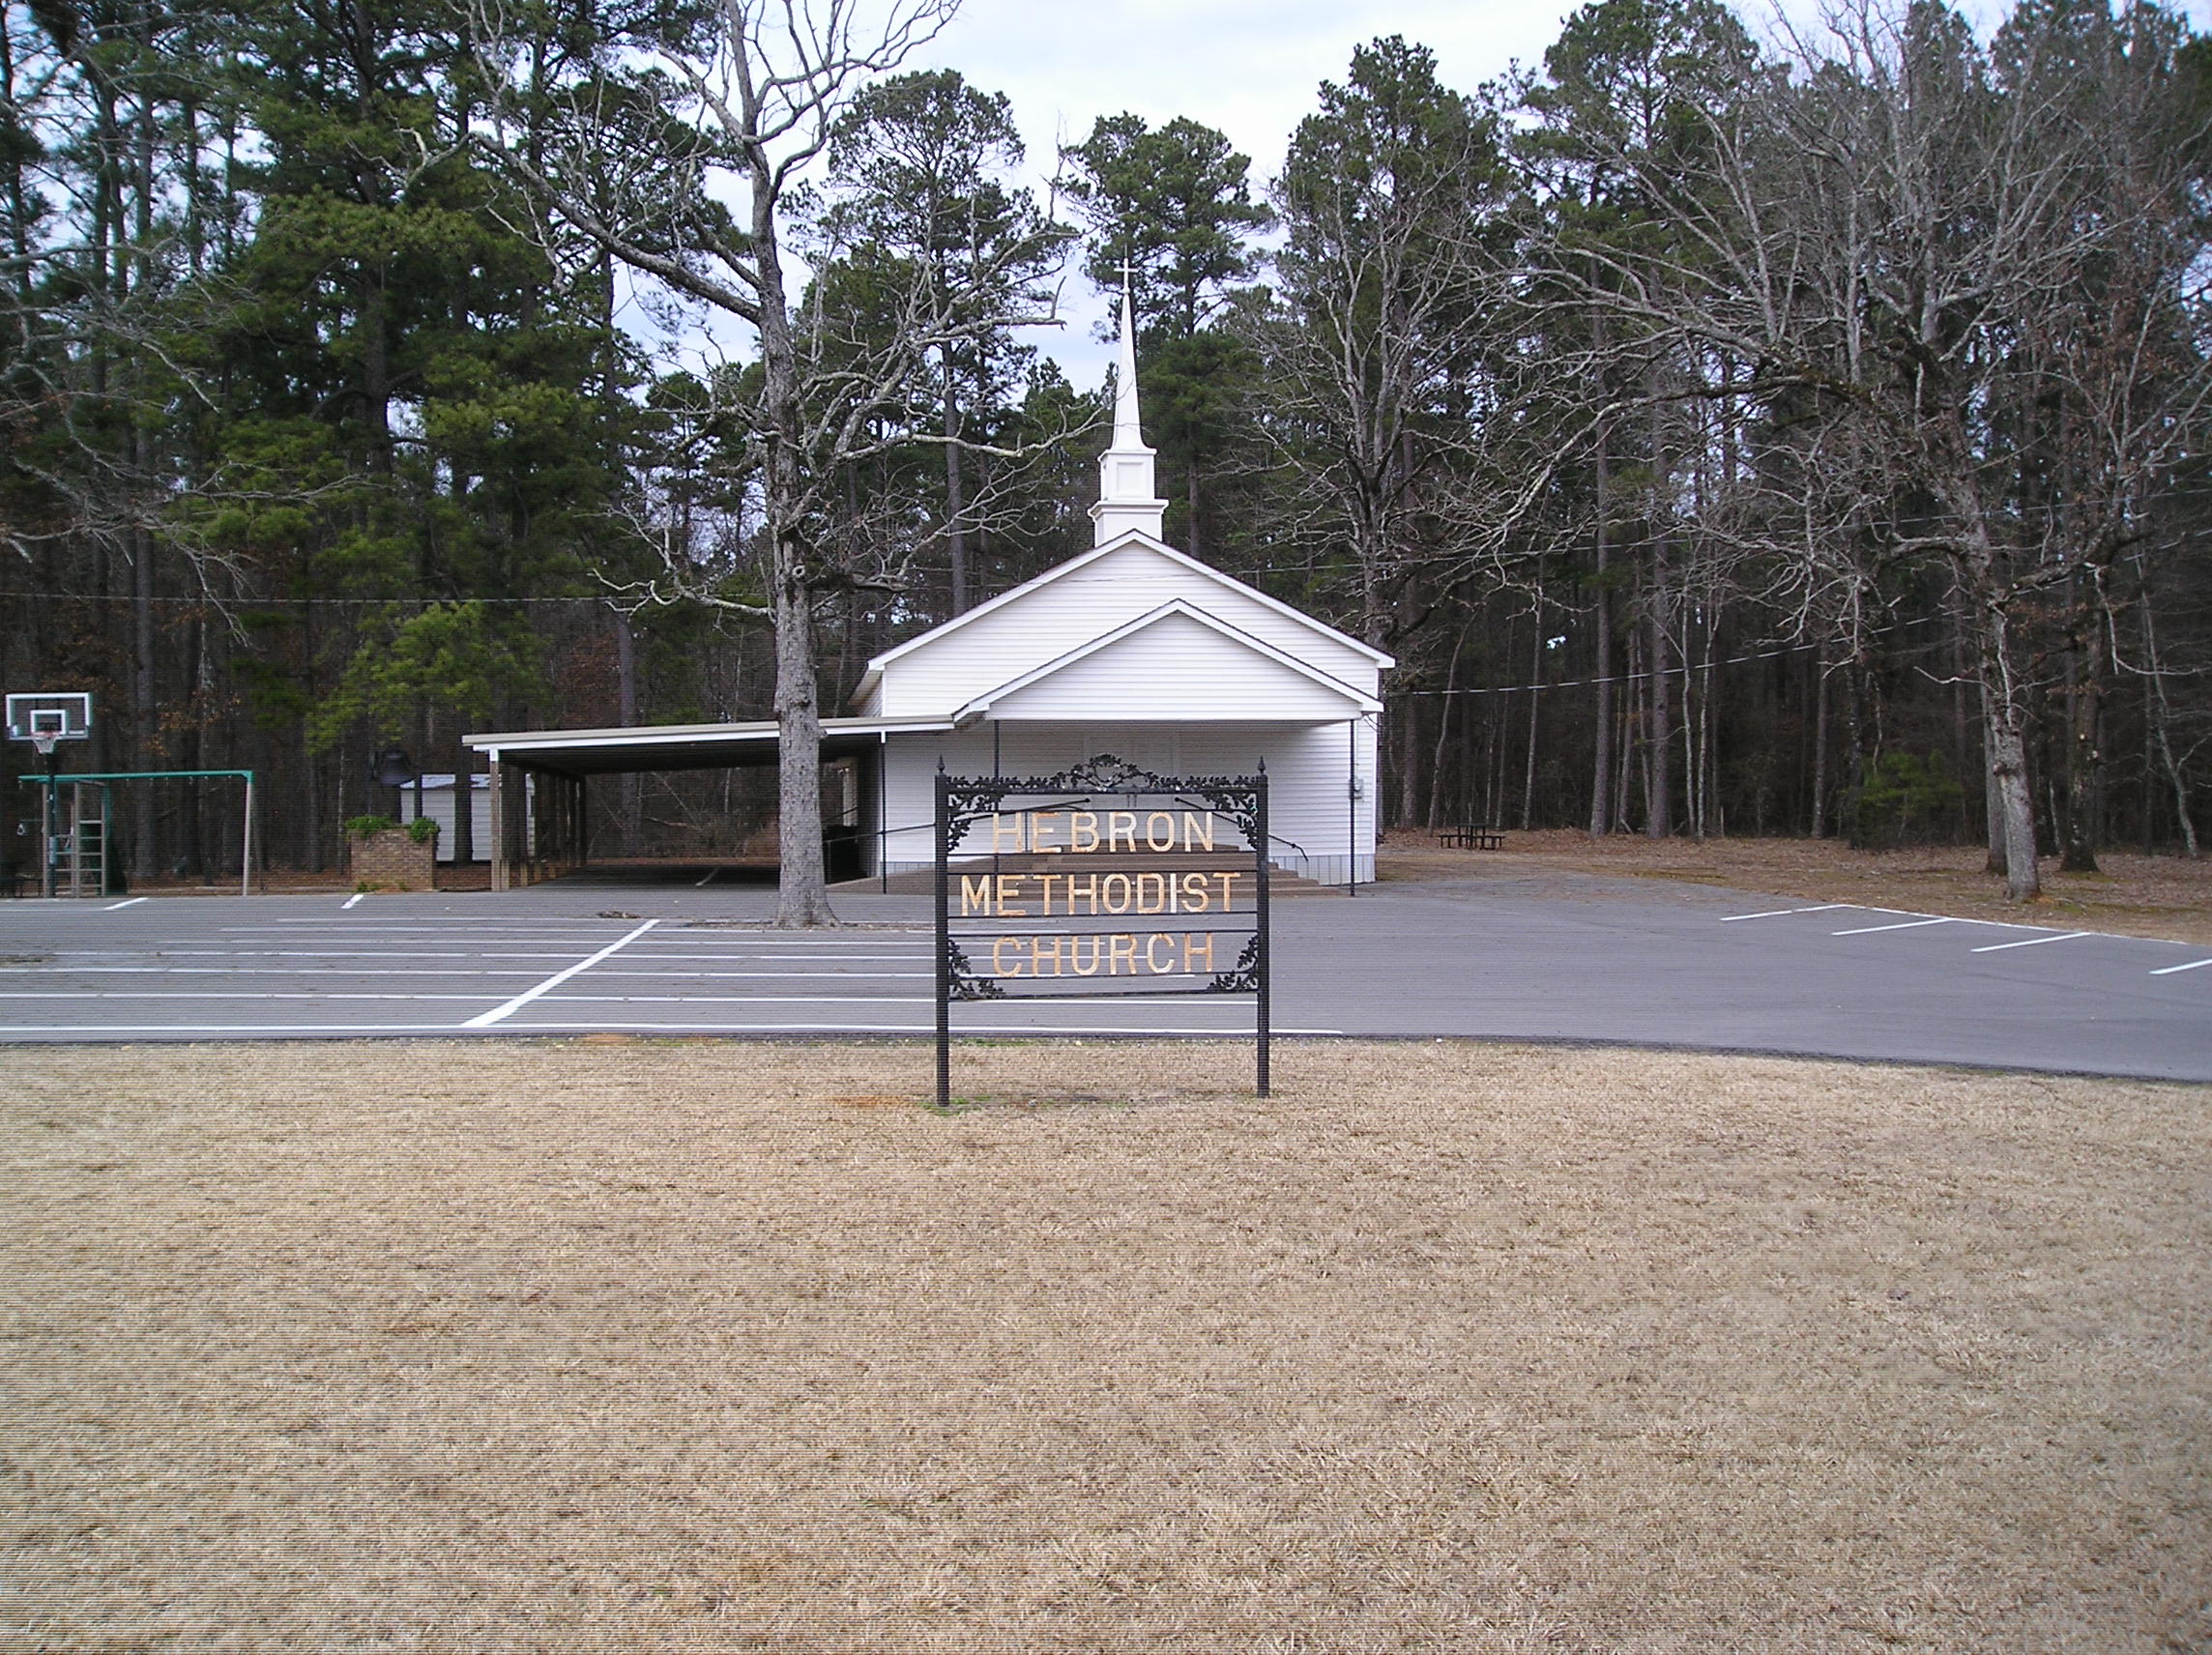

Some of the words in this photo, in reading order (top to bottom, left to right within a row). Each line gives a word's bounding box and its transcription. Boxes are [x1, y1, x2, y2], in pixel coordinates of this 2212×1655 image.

[992, 811, 1214, 854] HEBRON
[960, 872, 1241, 916] METHODIST
[992, 933, 1214, 977] CHURCH
